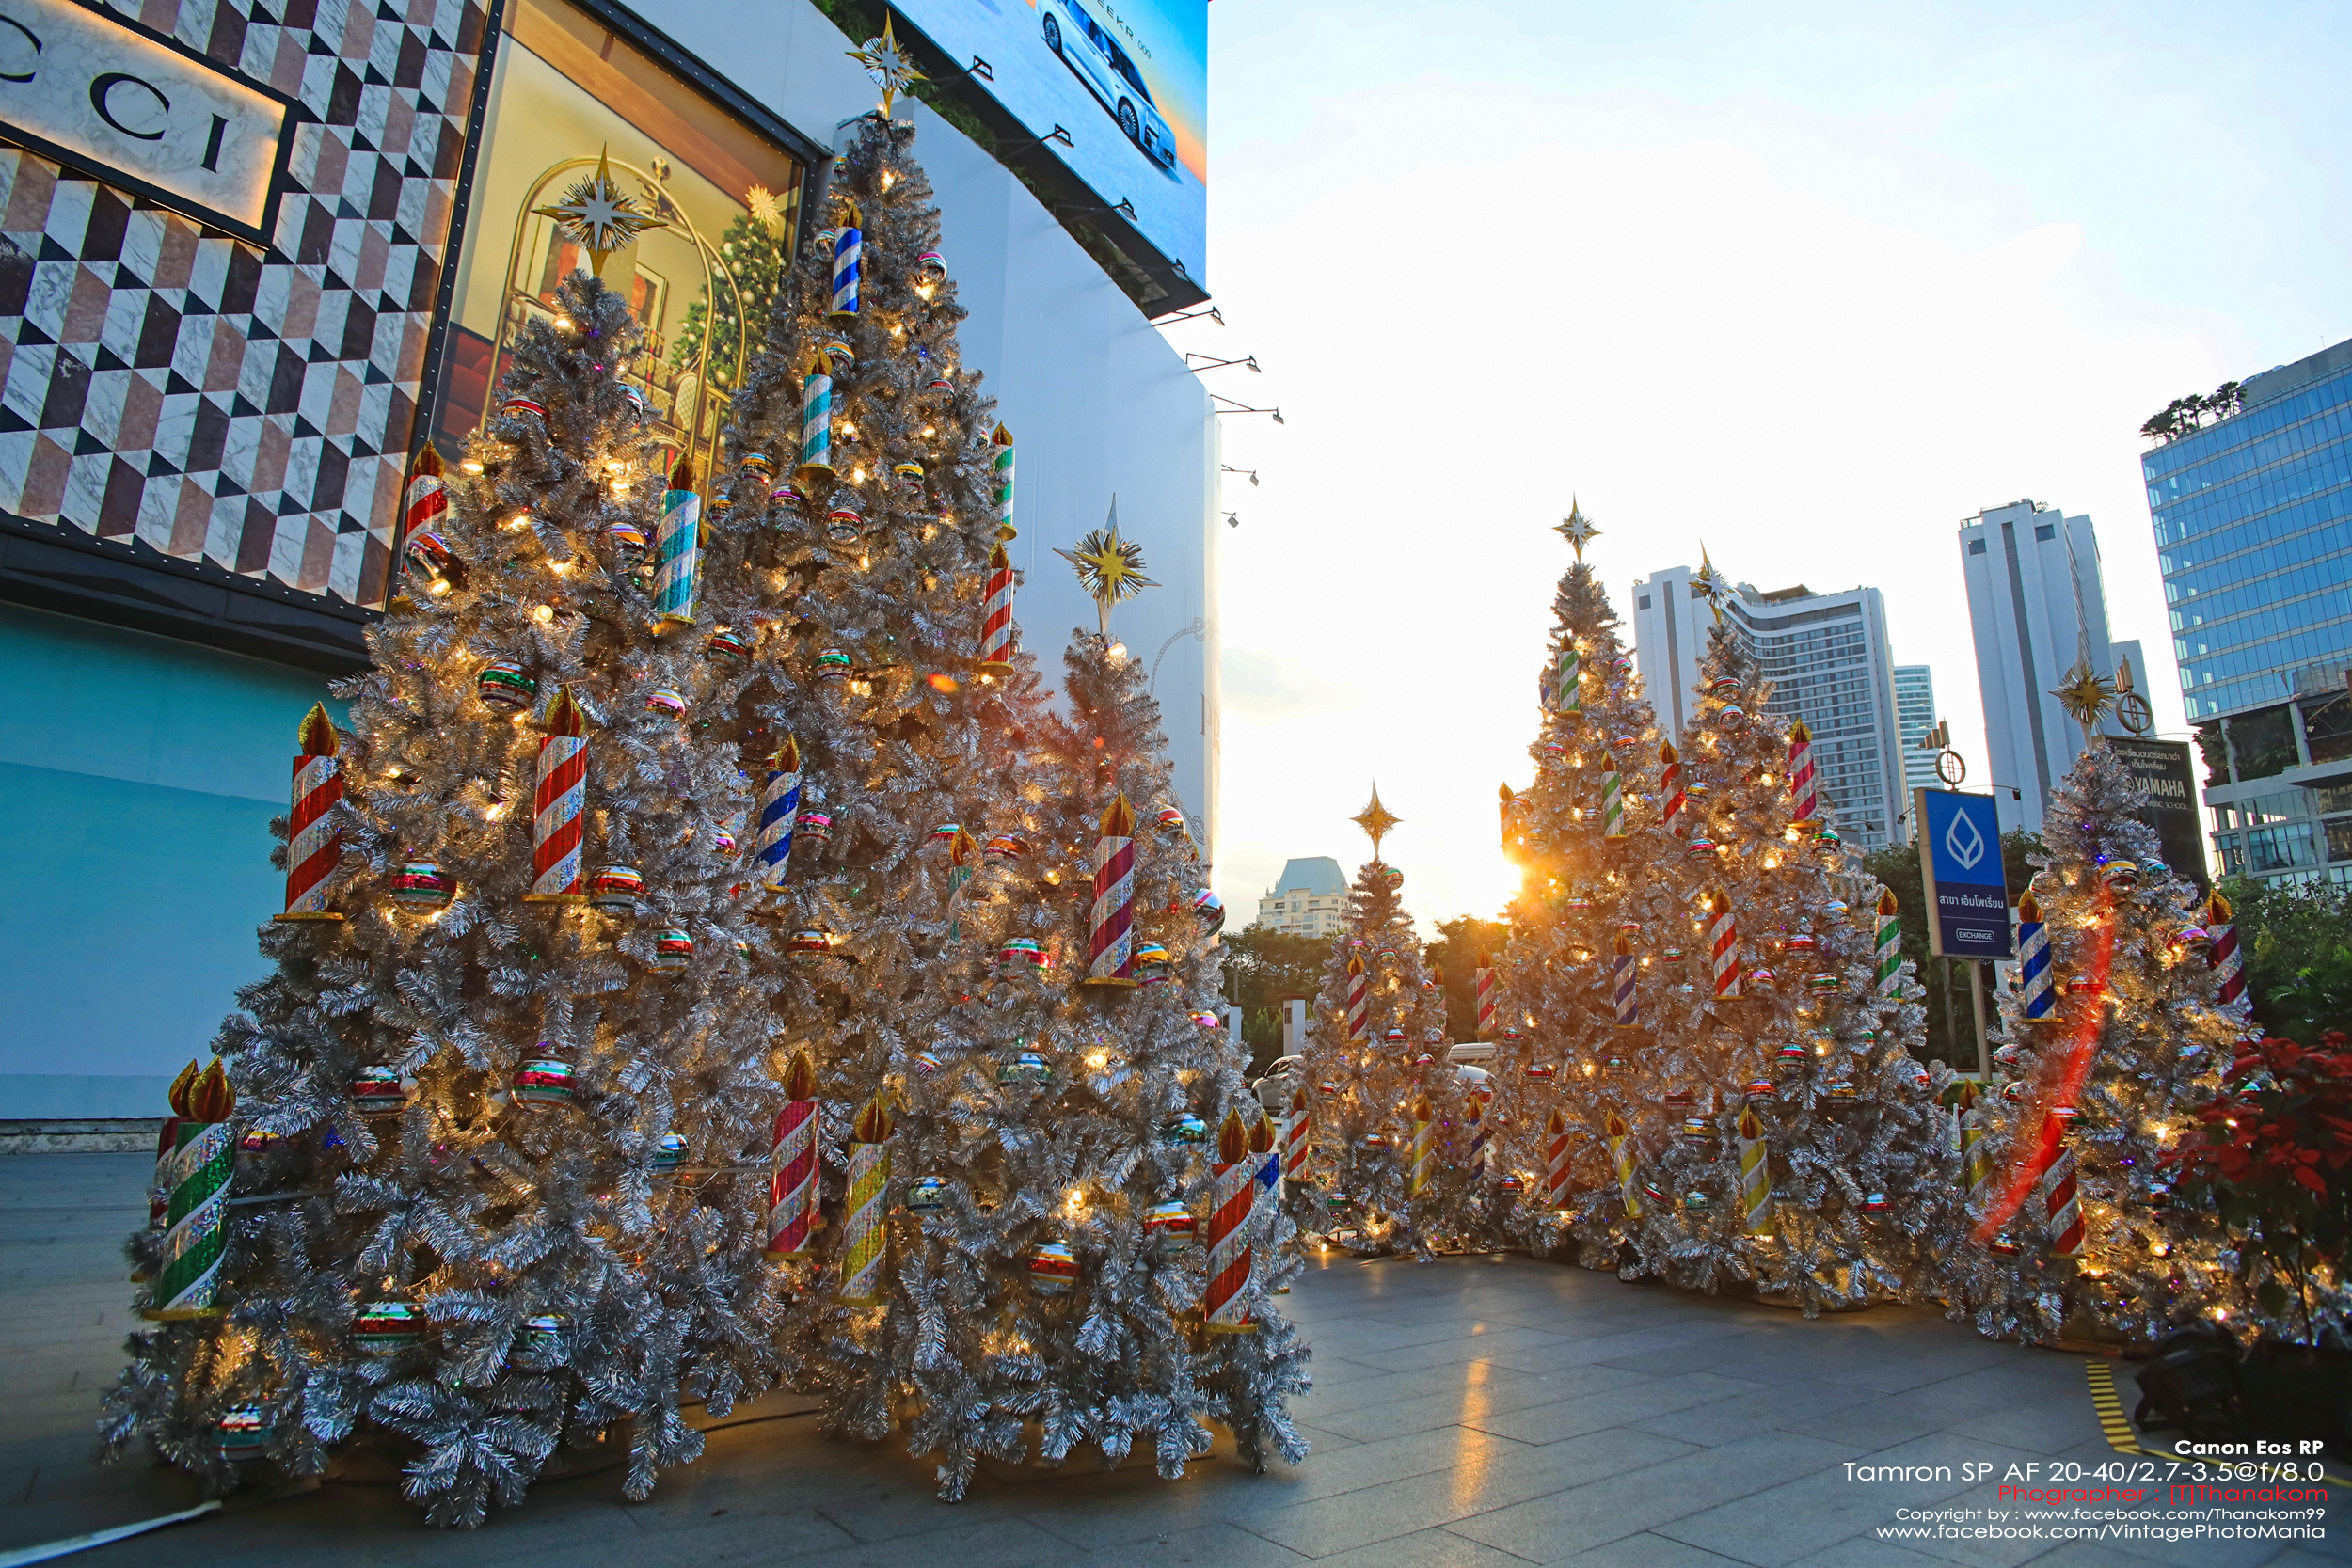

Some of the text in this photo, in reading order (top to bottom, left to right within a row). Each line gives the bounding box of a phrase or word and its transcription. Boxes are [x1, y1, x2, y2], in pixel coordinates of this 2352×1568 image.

[1137, 40, 1152, 59] 009
[2134, 776, 2186, 798] YAMAHA
[2165, 801, 2188, 810] SCHOOL
[1939, 894, 2004, 909] สาขา เอ็มโพเรี่ยม
[1958, 931, 1993, 940] EXCHANGE
